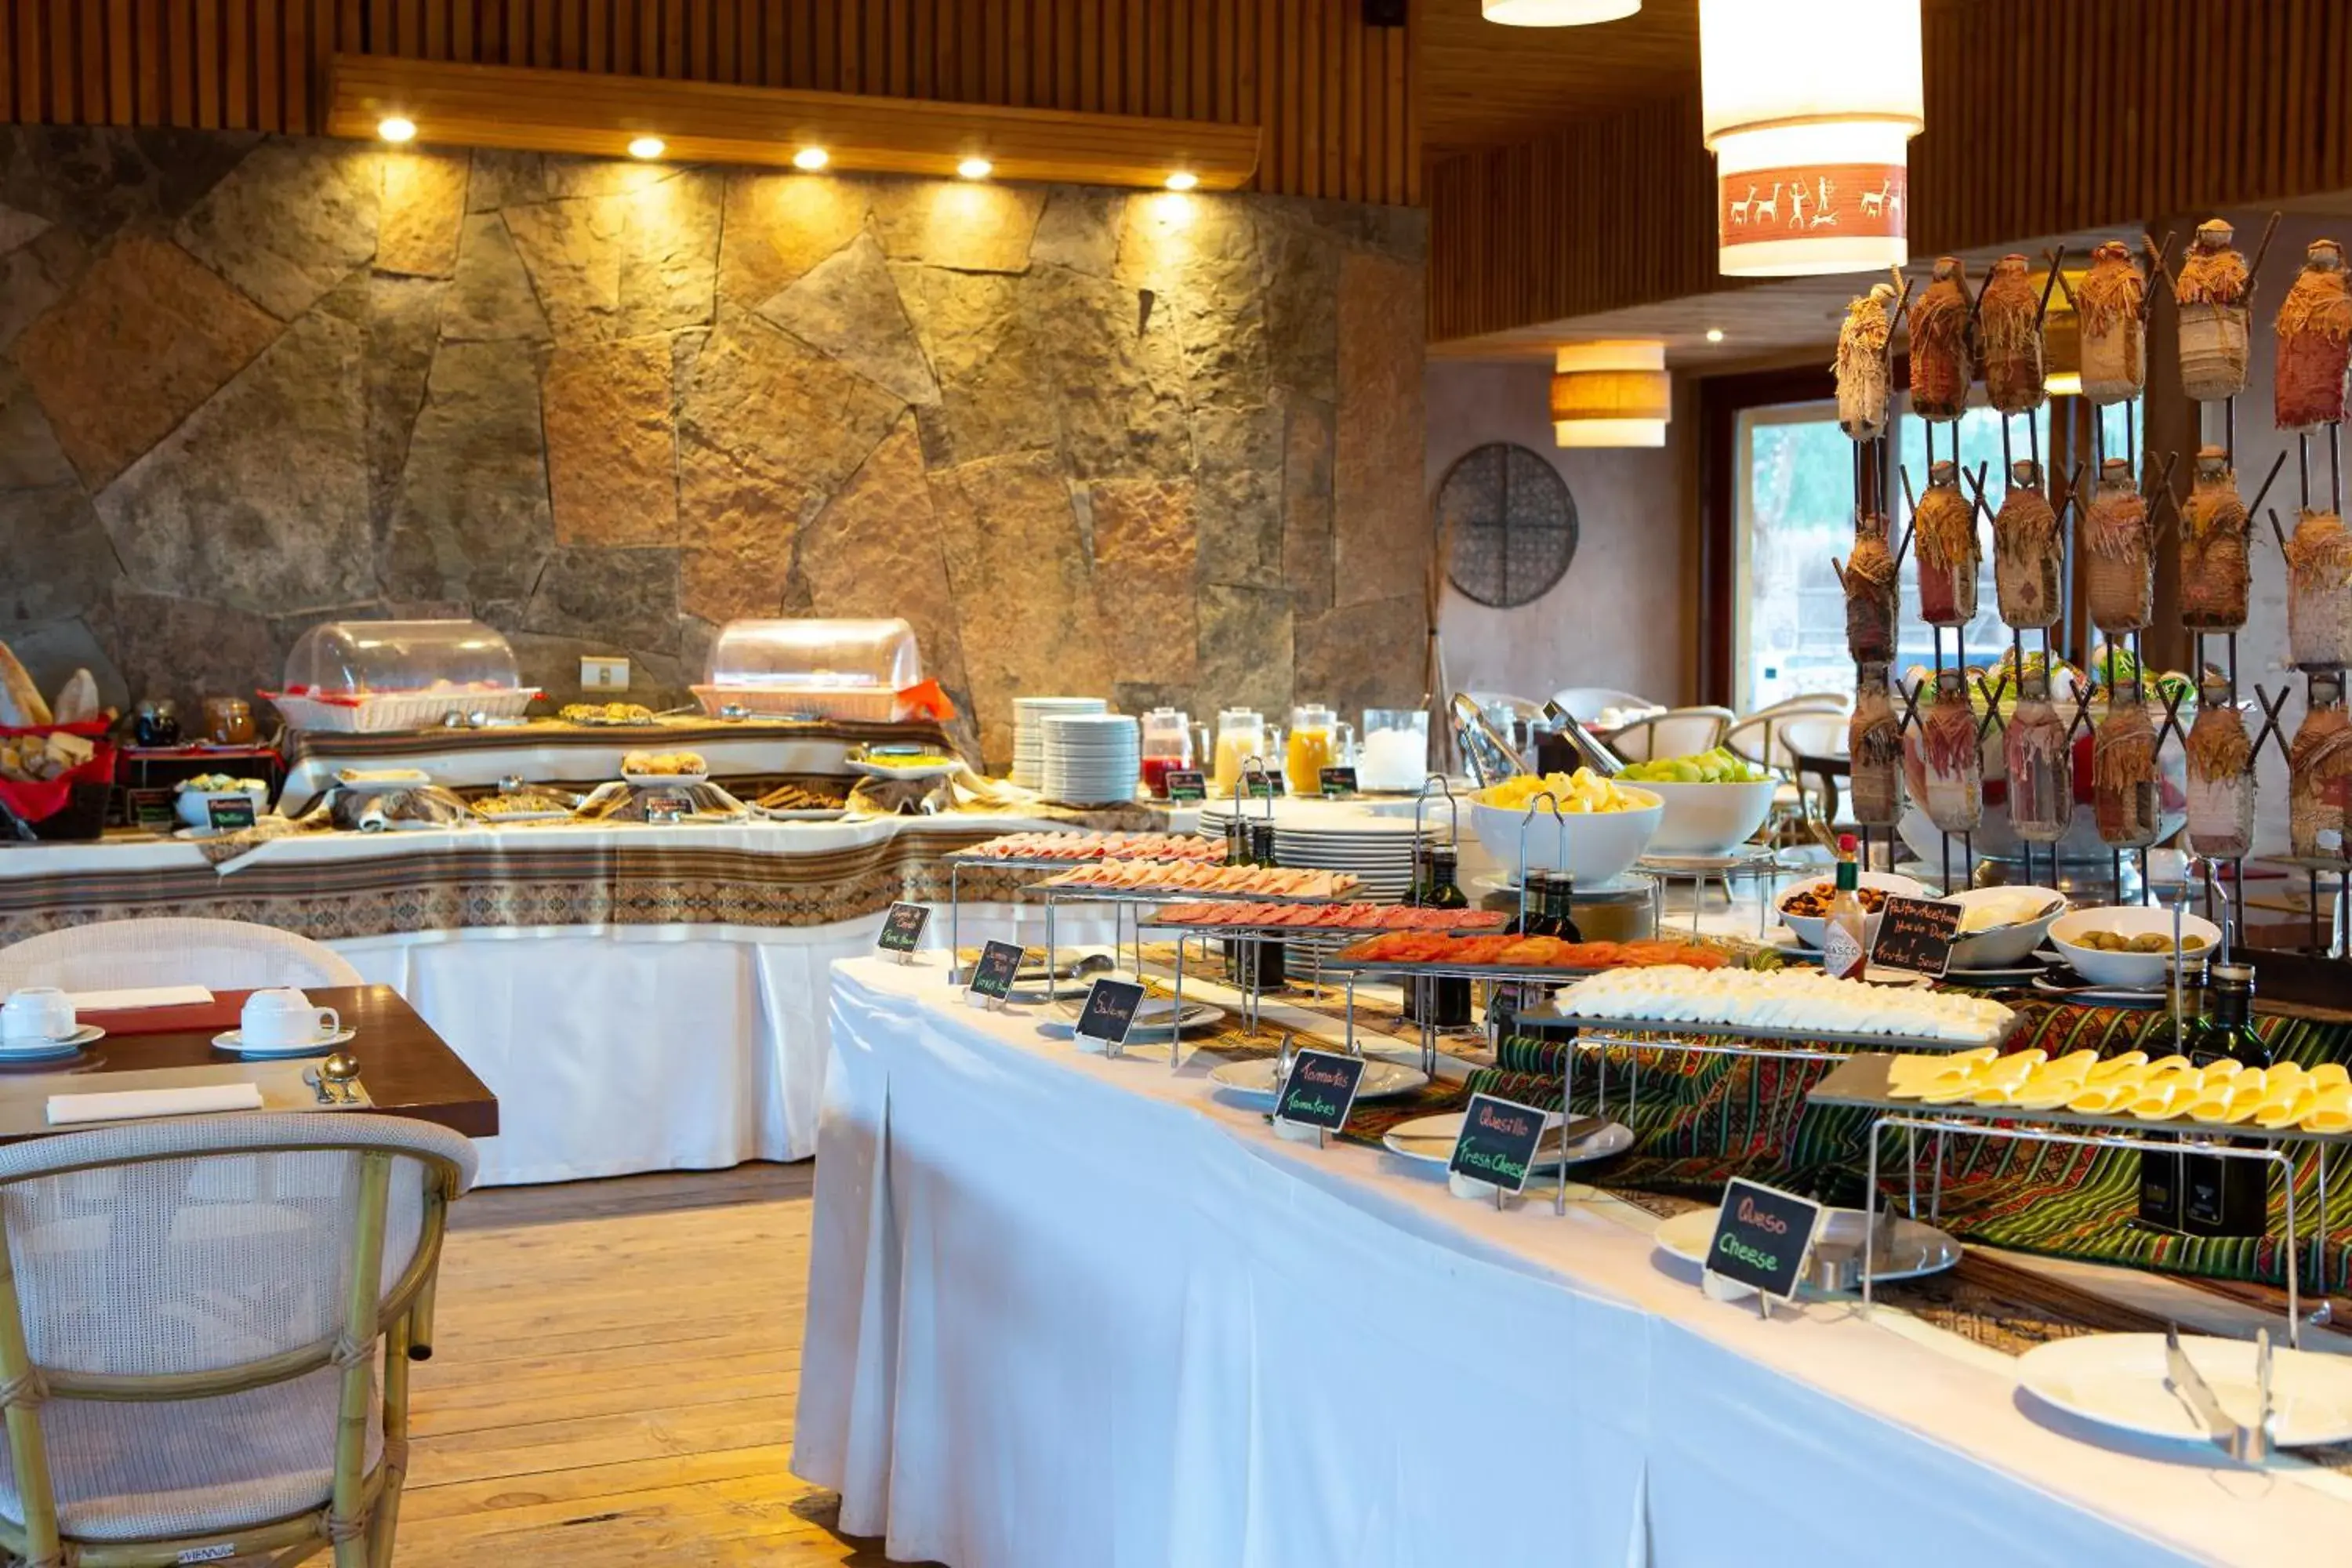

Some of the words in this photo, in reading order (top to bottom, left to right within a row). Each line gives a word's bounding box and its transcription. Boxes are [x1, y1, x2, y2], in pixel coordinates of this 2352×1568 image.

[1287, 1088, 1337, 1116] Tomatoes
[1459, 1135, 1492, 1170] Fresh
[1492, 1153, 1526, 1179] Cheese
[1737, 1196, 1788, 1235] Queso
[1719, 1232, 1780, 1272] Cheese
